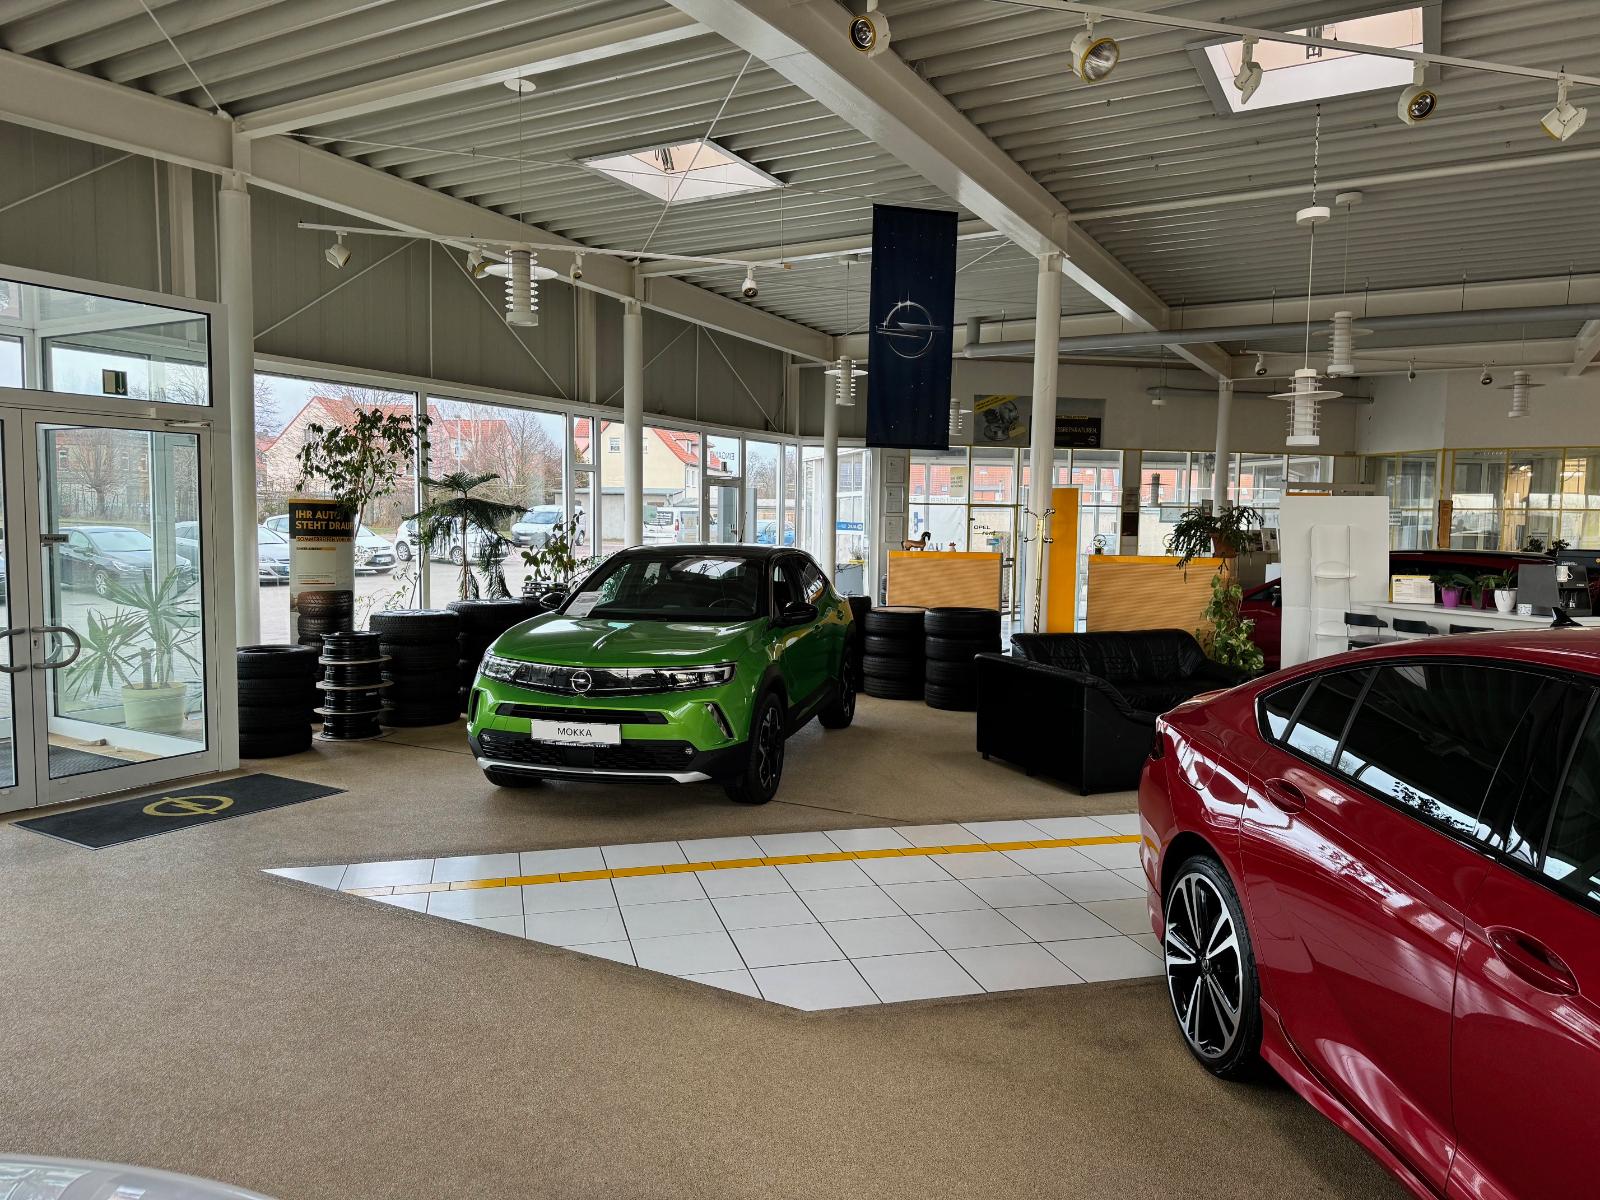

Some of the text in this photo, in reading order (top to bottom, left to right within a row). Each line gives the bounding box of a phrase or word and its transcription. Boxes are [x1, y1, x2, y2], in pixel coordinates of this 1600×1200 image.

[296, 509, 312, 519] IHR
[295, 520, 328, 530] STEHT
[557, 728, 592, 737] MOKKA
